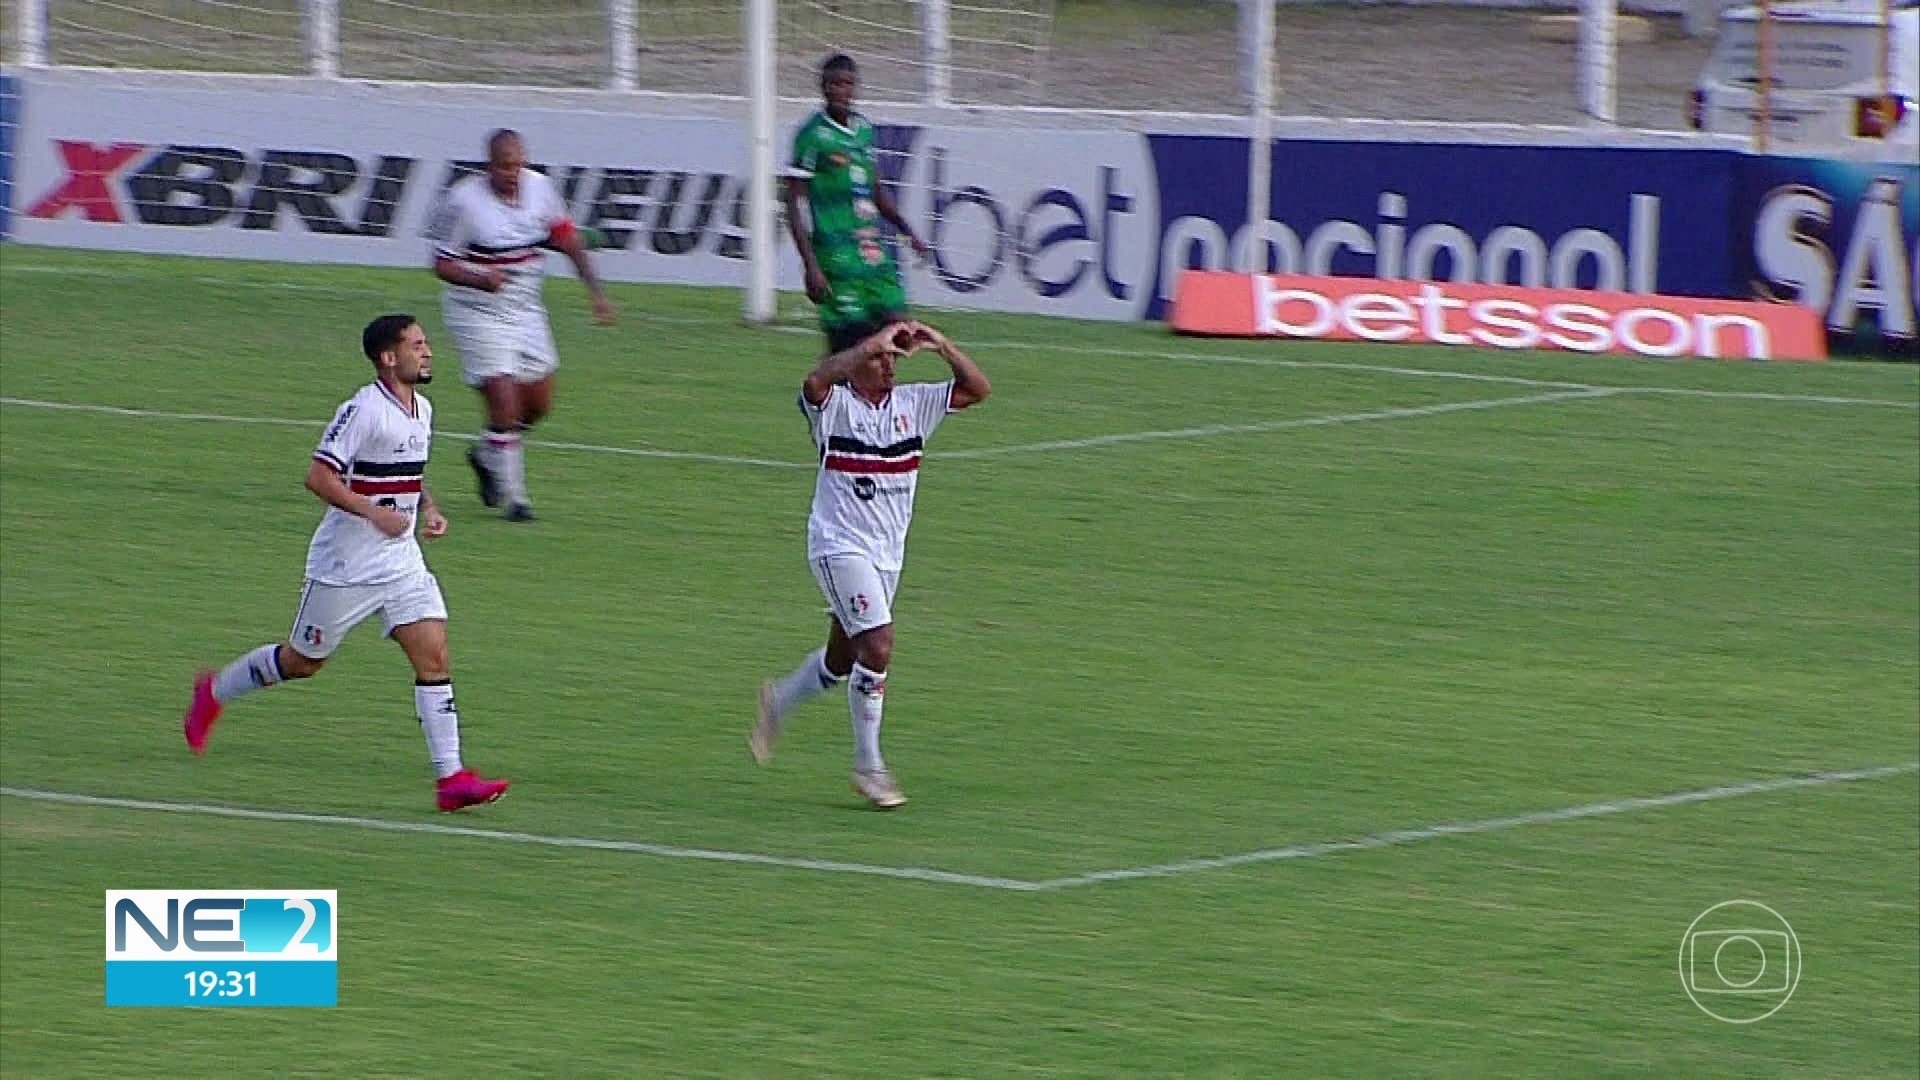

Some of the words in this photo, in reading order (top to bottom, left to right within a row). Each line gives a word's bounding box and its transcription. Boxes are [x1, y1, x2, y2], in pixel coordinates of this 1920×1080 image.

[27, 140, 417, 237] XBRI
[928, 147, 1137, 300] bet
[1254, 274, 1770, 360] betsson
[1754, 176, 1920, 338] SÁ
